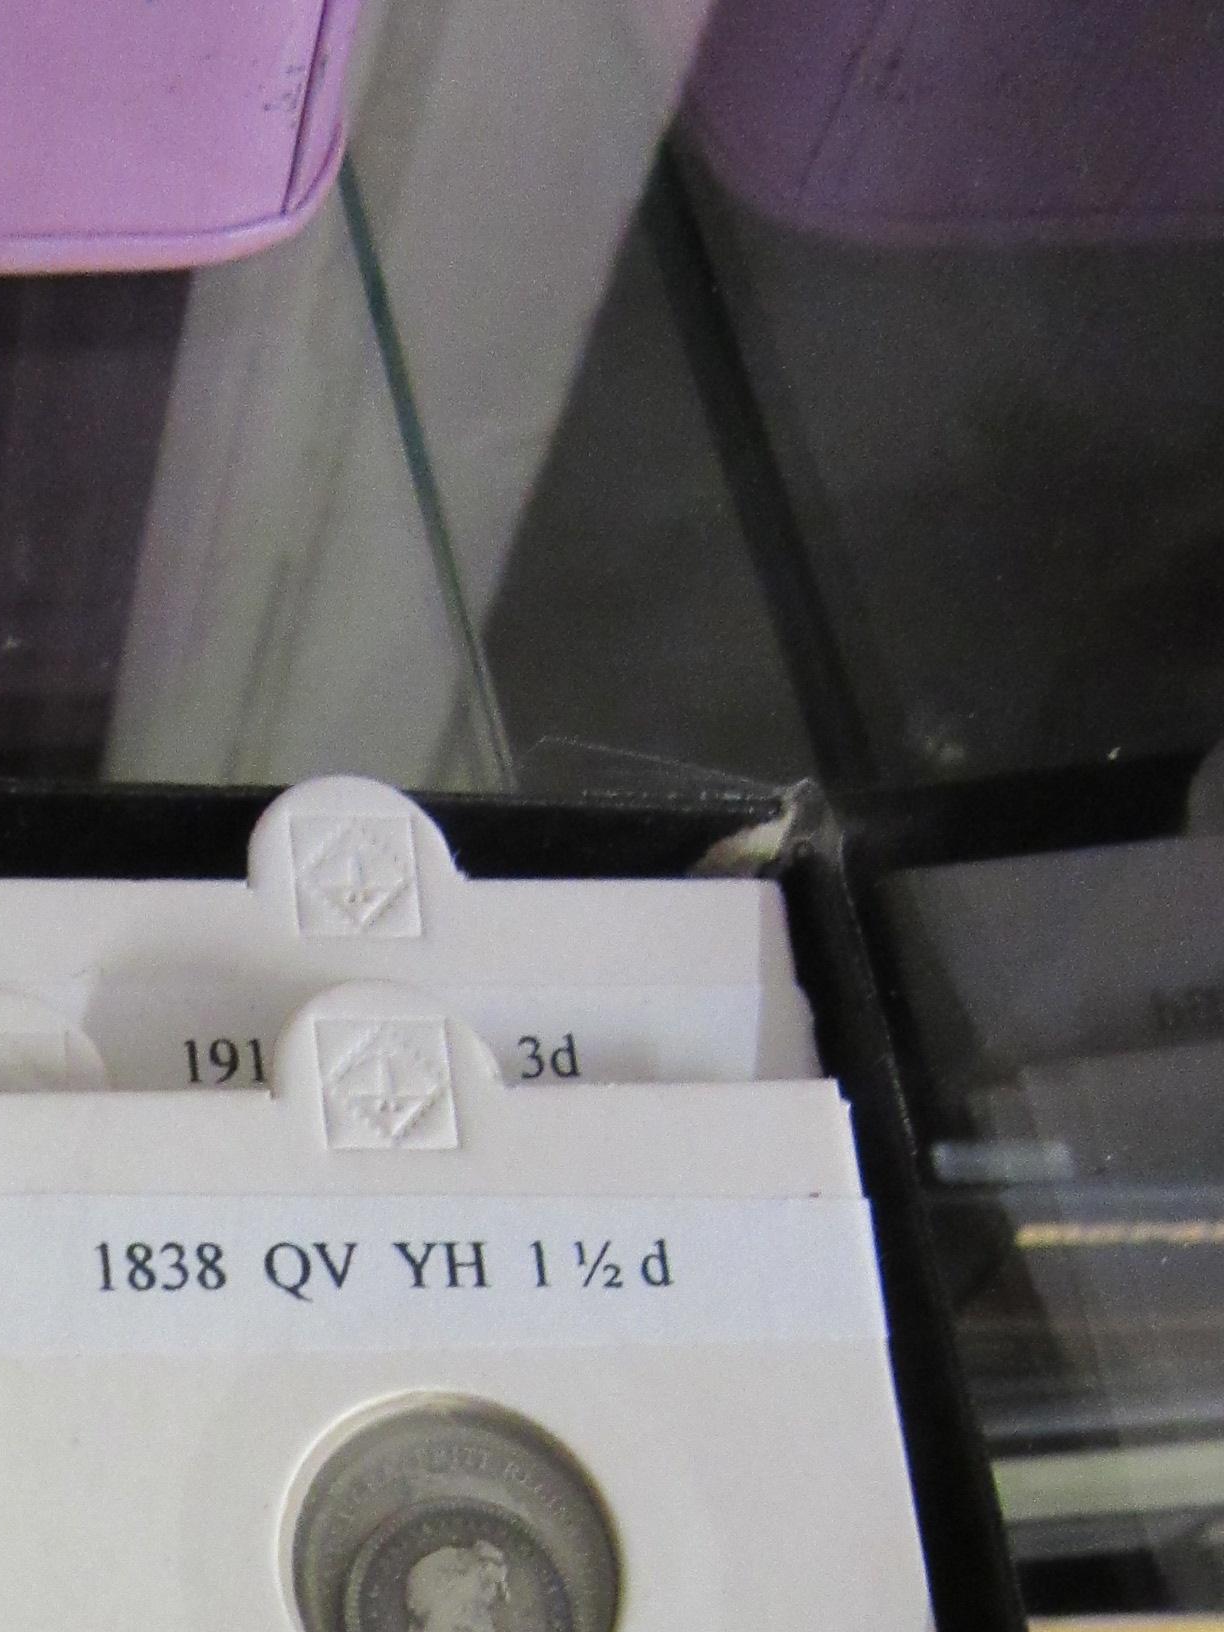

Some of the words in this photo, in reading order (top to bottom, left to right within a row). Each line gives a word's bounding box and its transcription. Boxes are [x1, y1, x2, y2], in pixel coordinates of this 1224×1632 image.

[516, 1031, 582, 1080] 3d
[93, 1239, 228, 1293] 1838
[262, 1239, 359, 1302] QV
[392, 1238, 489, 1290] YH
